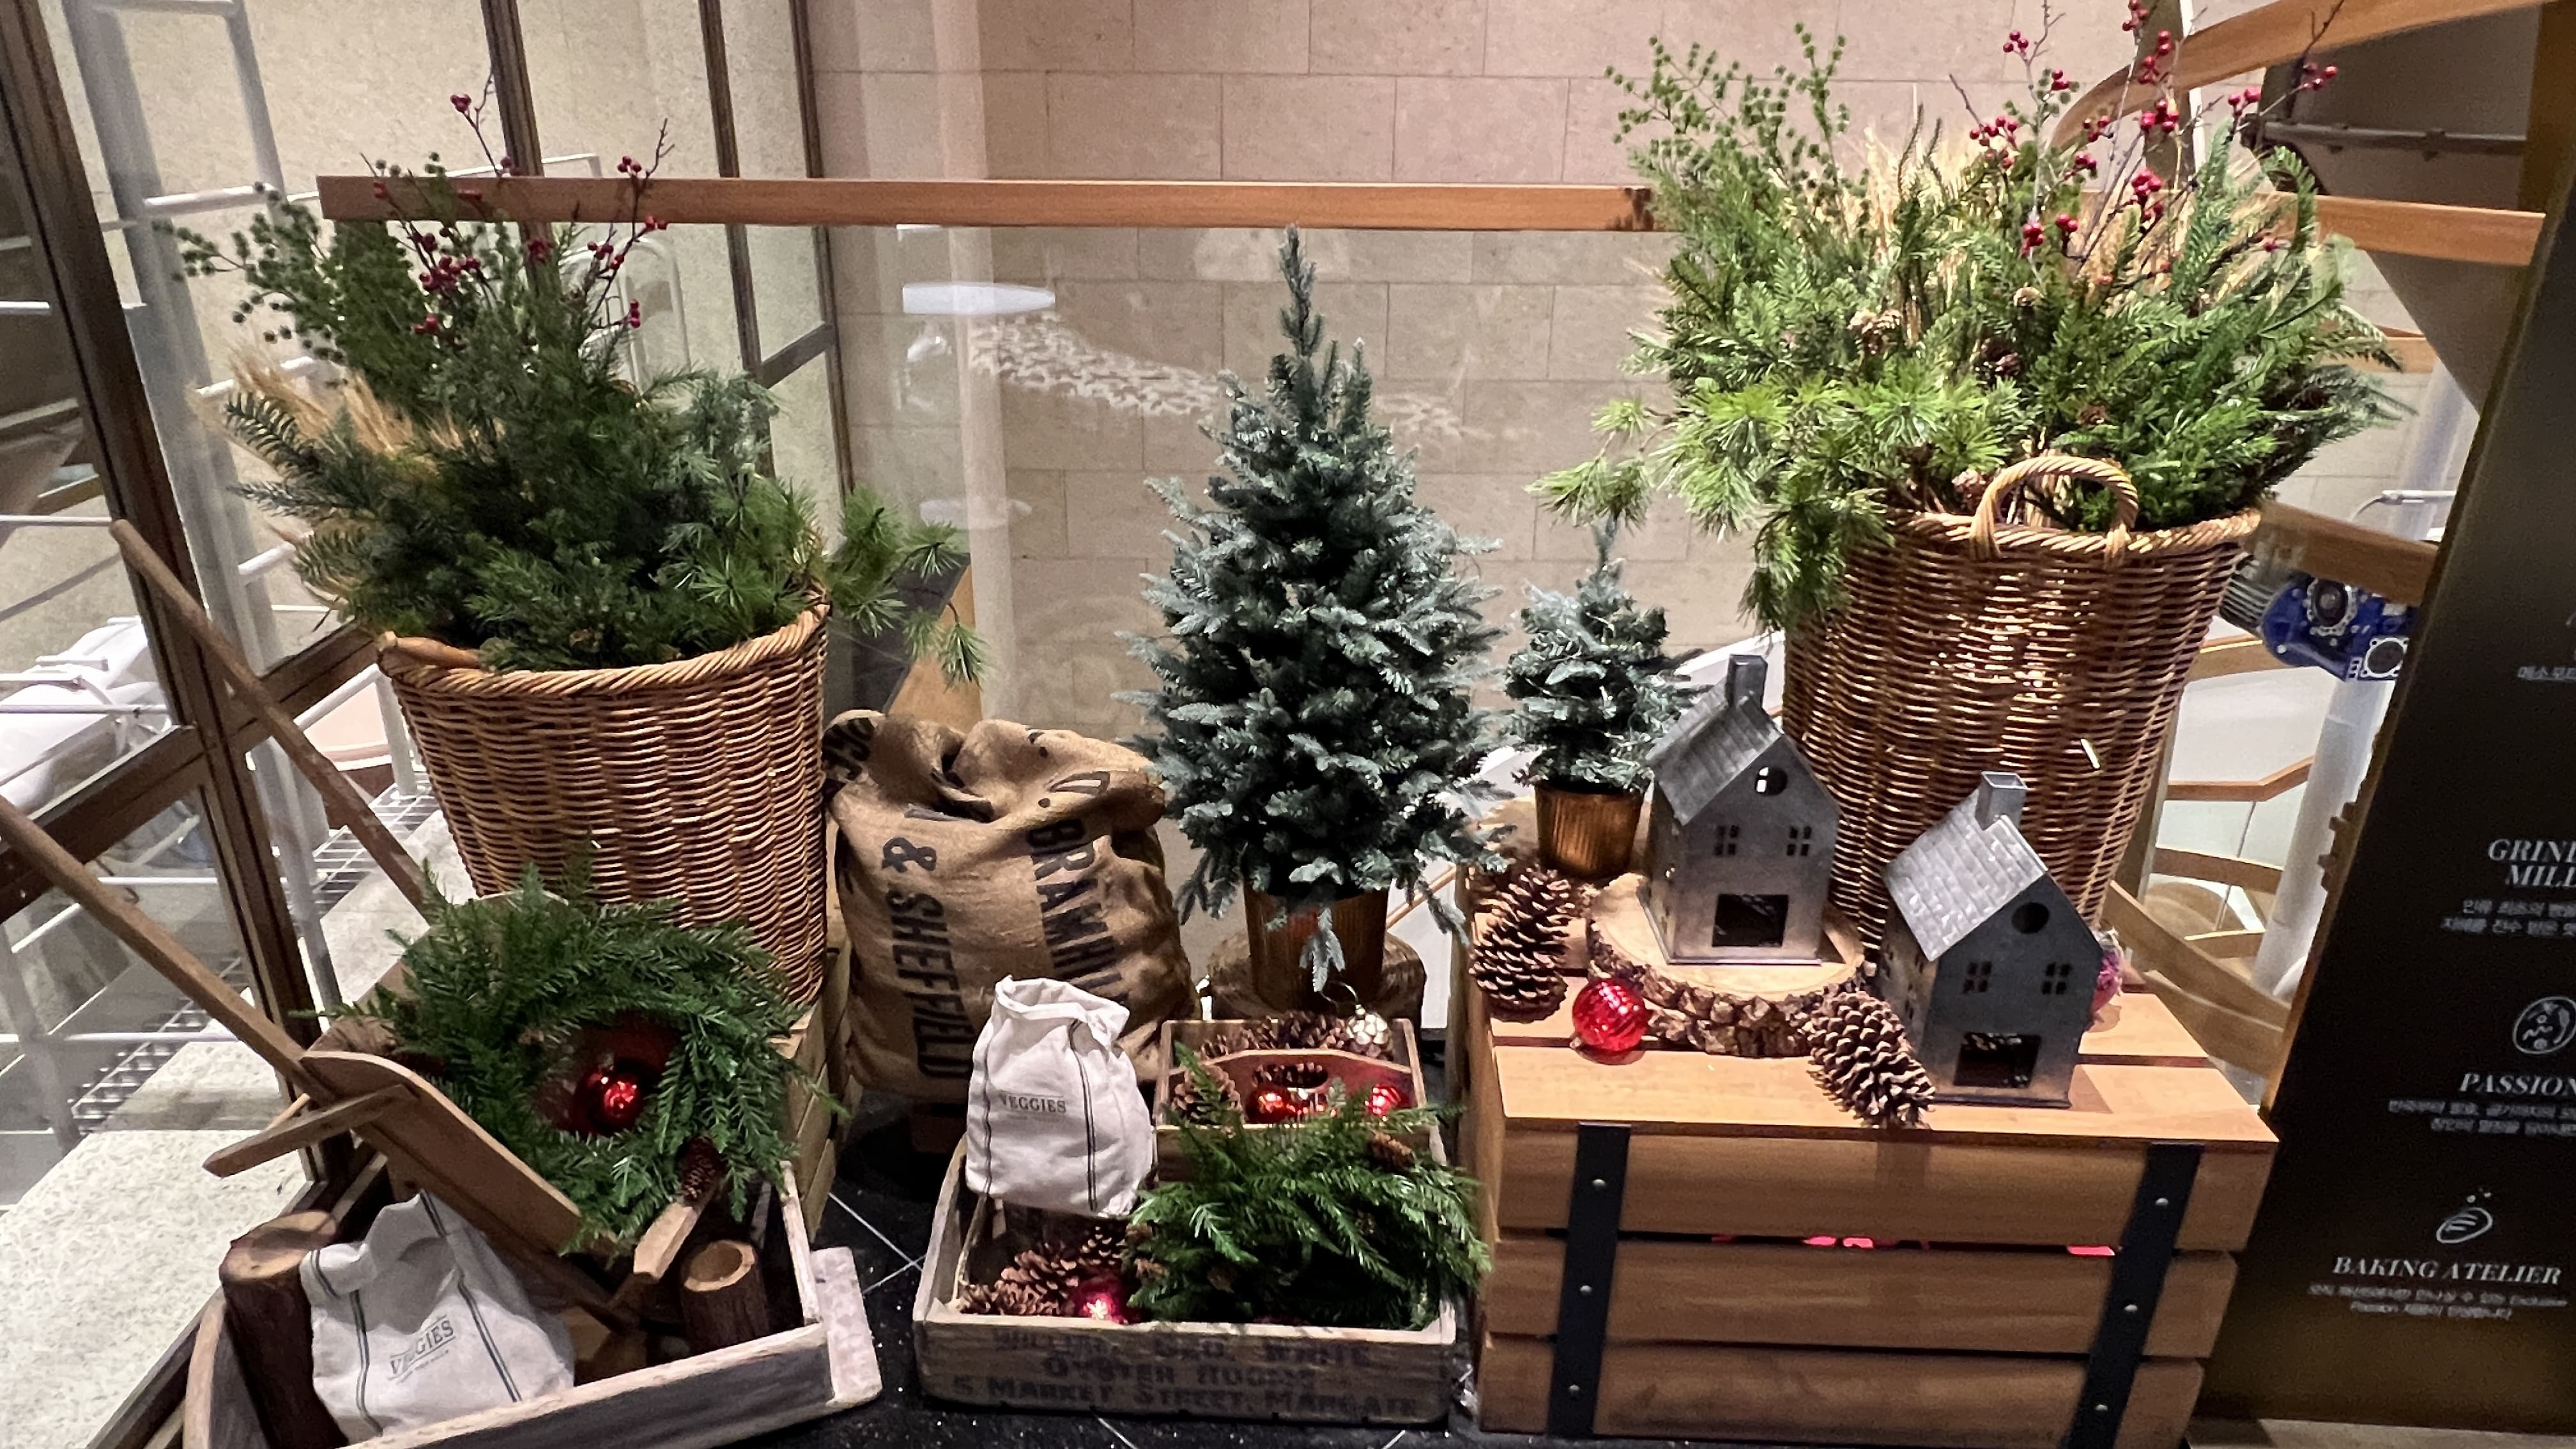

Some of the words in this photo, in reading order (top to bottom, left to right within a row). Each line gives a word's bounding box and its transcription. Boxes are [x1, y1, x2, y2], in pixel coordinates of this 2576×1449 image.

[881, 838, 937, 873] &
[887, 888, 977, 1078] SHEFFIELD
[999, 1093, 1067, 1114] VEGGIES
[2333, 1256, 2438, 1278] BAKING
[2442, 1262, 2562, 1285] ATELIER
[390, 1320, 454, 1374] VGIES
